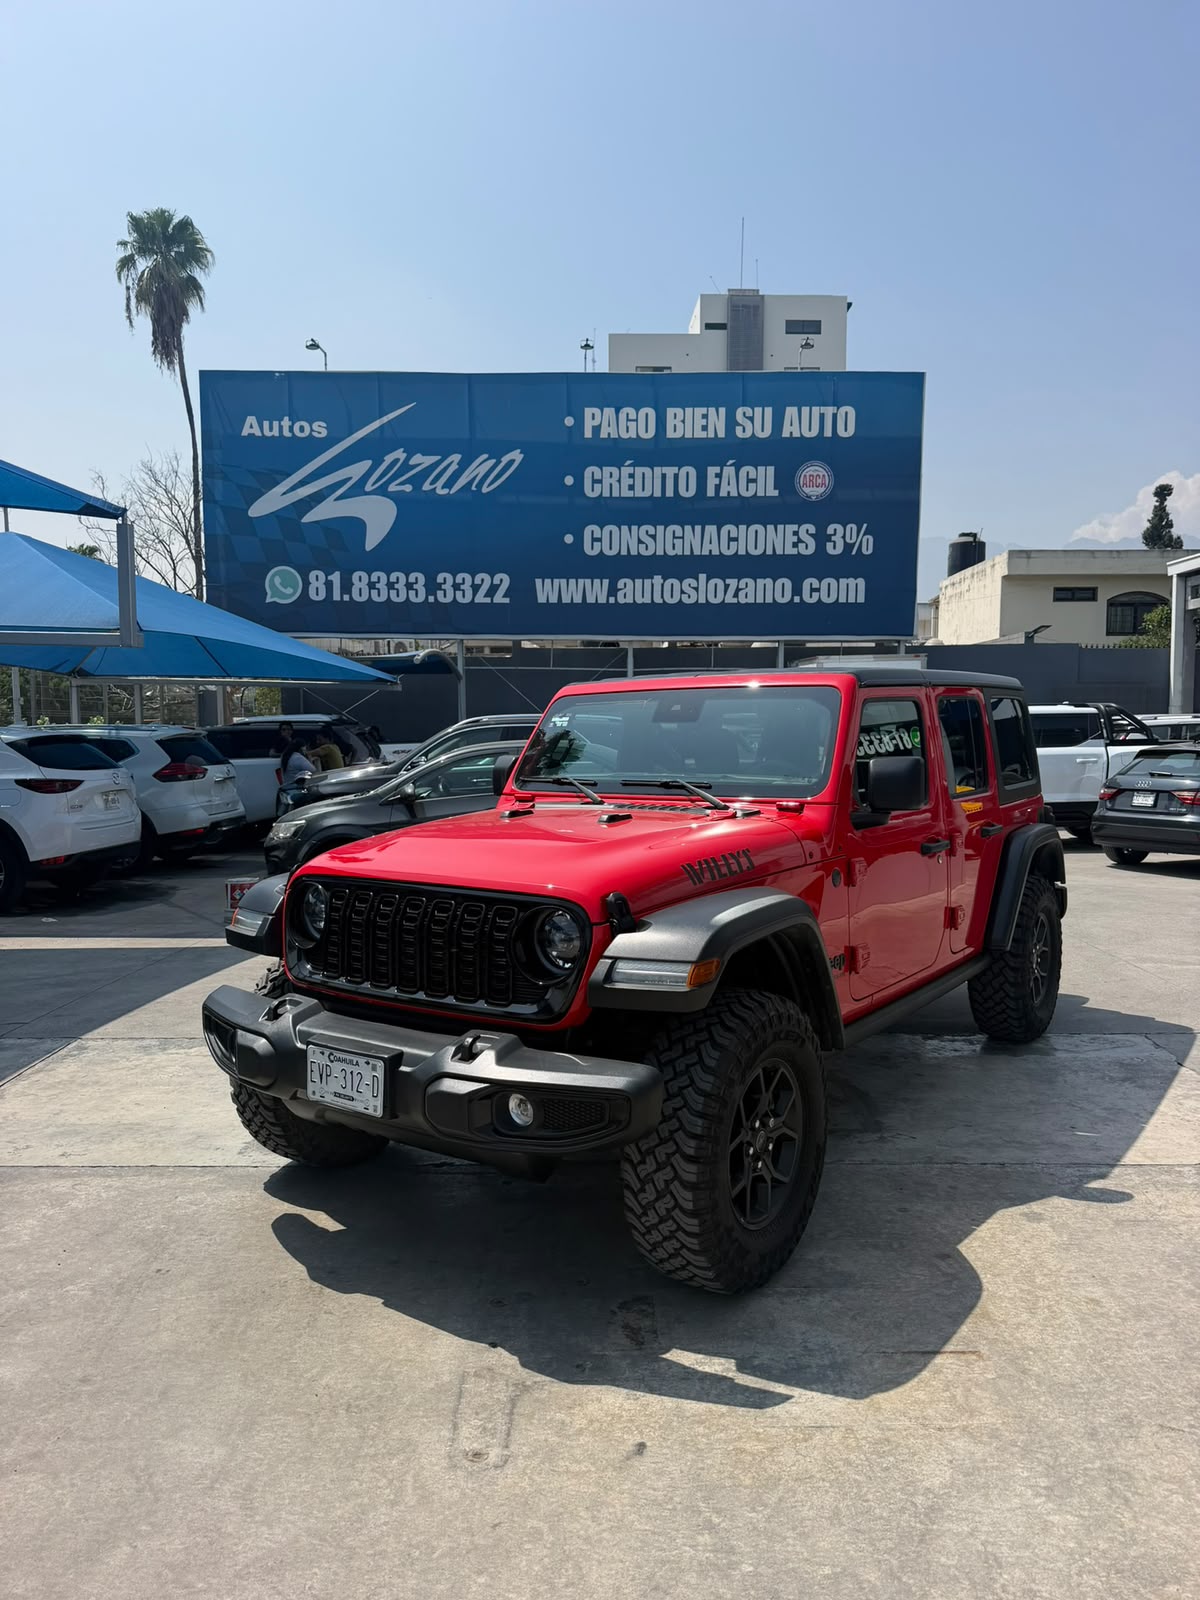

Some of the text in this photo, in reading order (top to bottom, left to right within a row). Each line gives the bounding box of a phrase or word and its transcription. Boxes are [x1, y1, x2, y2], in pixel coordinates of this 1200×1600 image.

[241, 415, 328, 438] Autos
[583, 405, 856, 440] PAGO BIEN SU AUTO
[583, 459, 779, 498] CRÉDITO FÁCIL
[802, 473, 827, 488] ARCA
[583, 522, 874, 556] CONSIGNACIONES 3%
[308, 570, 511, 604] 81.8333.3322
[535, 573, 866, 604] www.autoslozano.com
[680, 848, 755, 886] WILLYS
[327, 1052, 360, 1067] COAHUILA
[310, 1060, 379, 1098] EVP-312-D
